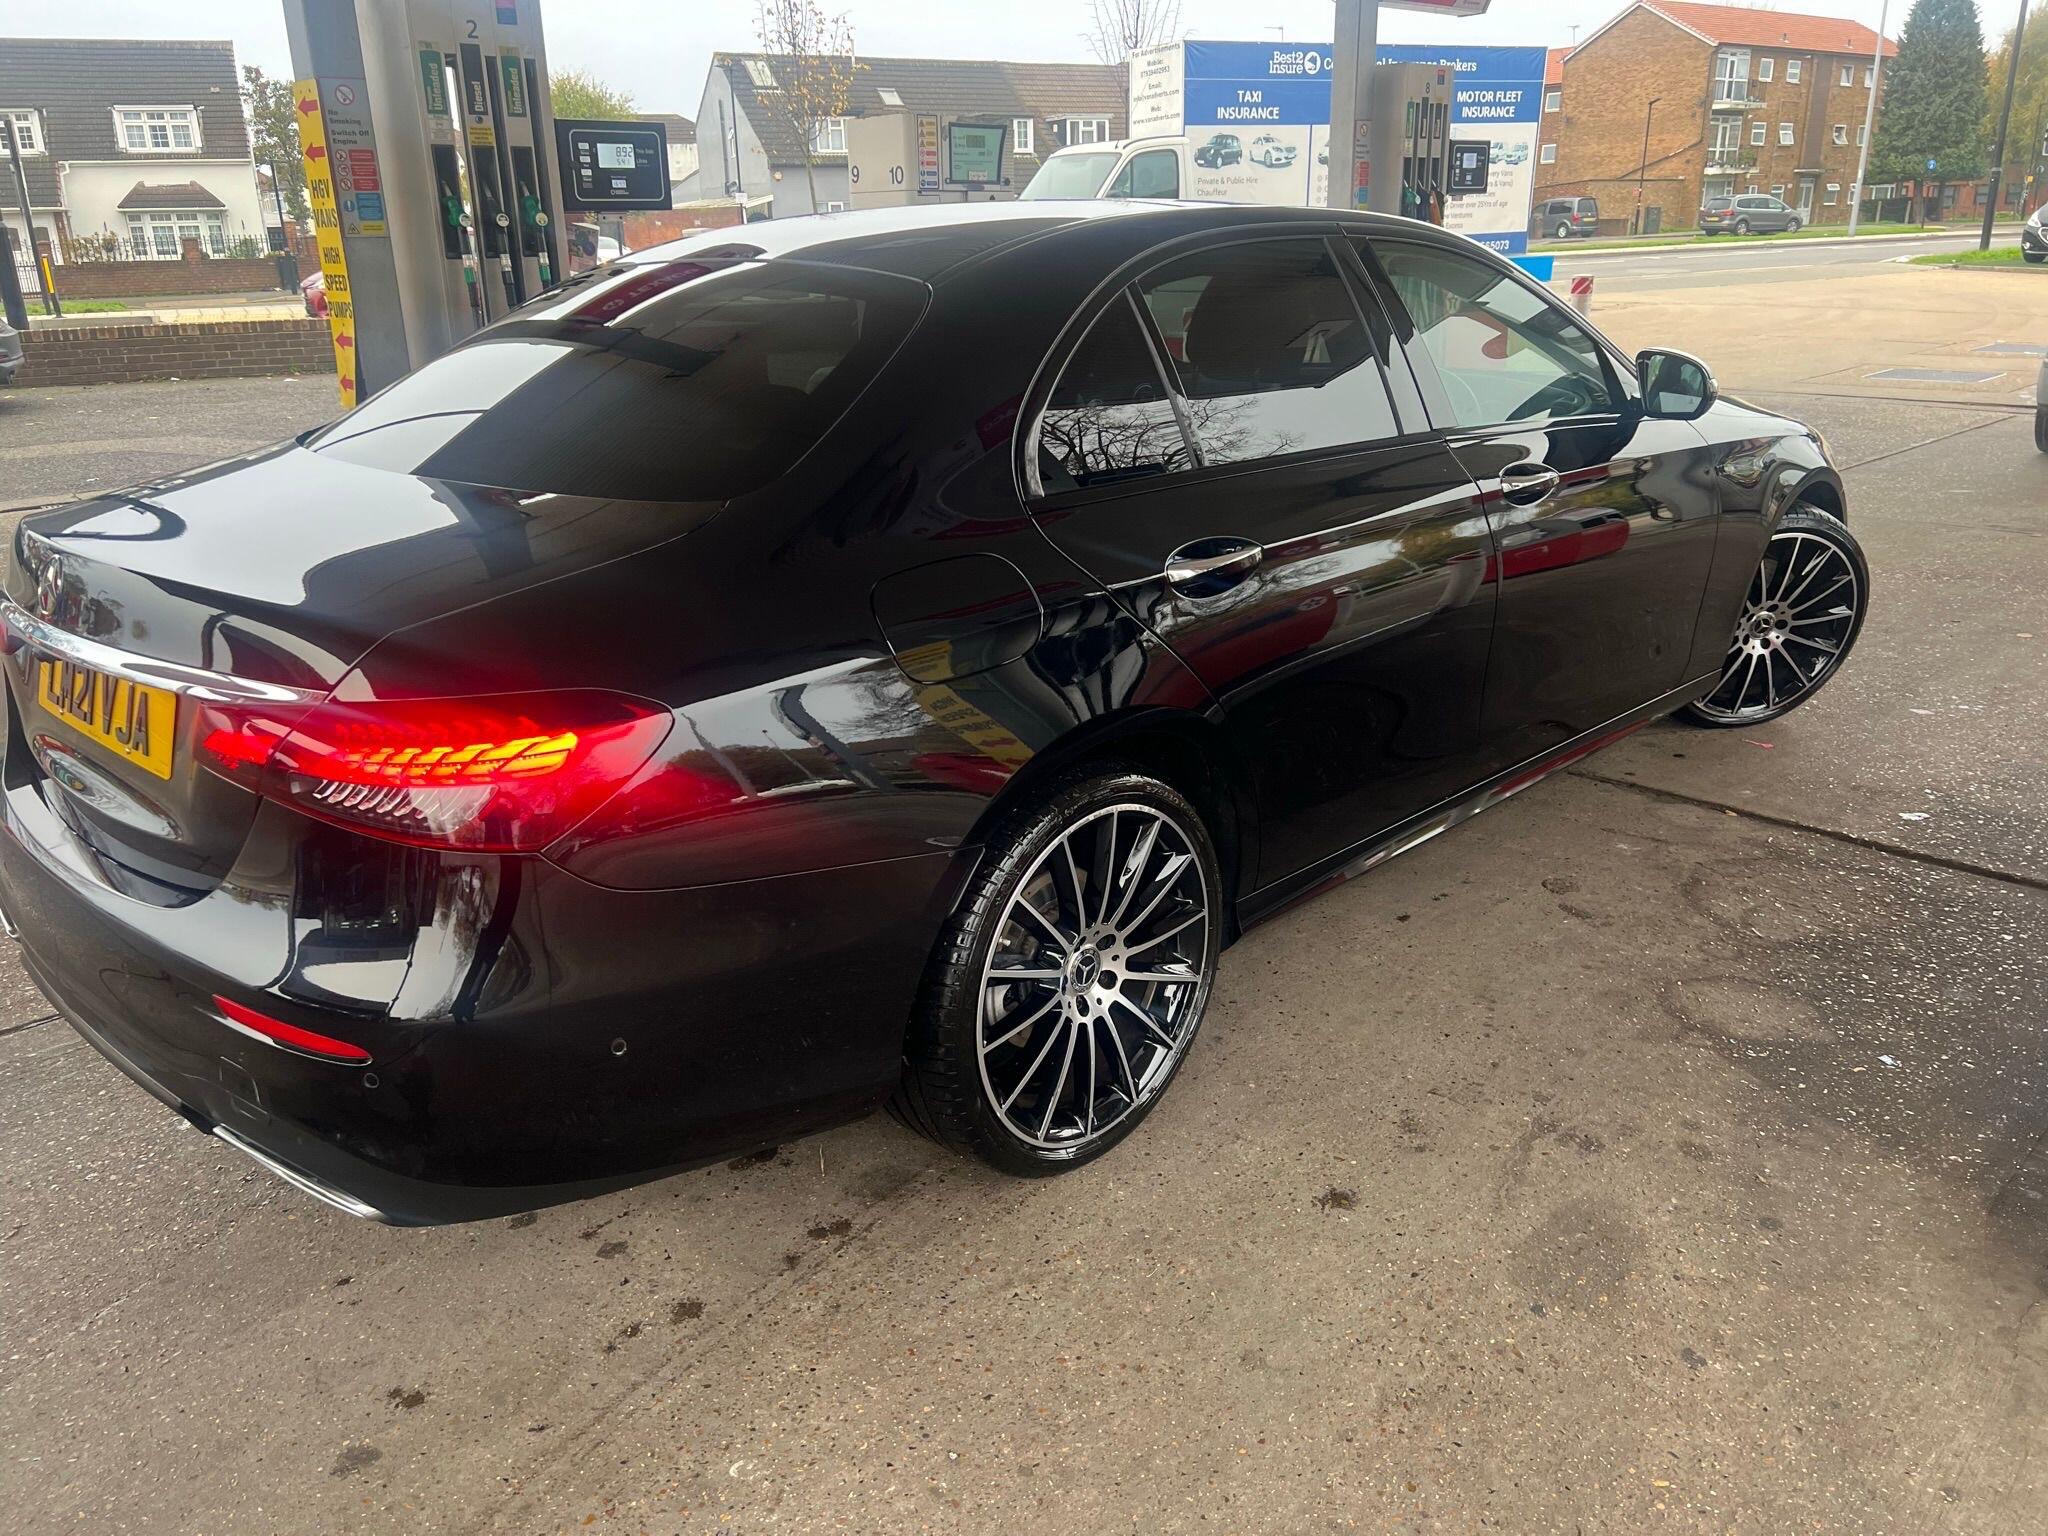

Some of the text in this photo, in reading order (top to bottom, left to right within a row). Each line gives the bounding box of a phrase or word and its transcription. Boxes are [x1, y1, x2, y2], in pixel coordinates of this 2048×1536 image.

[466, 20, 479, 38] 2
[1274, 51, 1304, 64] Best2
[1269, 60, 1304, 74] Insure
[428, 63, 443, 111] Unleaded
[509, 68, 523, 114] Unleaded
[1425, 82, 1431, 94] 8
[472, 81, 484, 112] Diesel
[1237, 90, 1262, 103] TAXI
[1457, 91, 1523, 103] MOTOR FLEET
[1217, 106, 1280, 120] INSURANCE
[1462, 106, 1516, 118] INSURANCE
[329, 118, 362, 126] Smoking
[331, 129, 357, 137] Switch
[332, 138, 358, 146] Engine
[851, 165, 860, 184] 9
[889, 165, 904, 184] 10
[1197, 177, 1220, 185] Private
[1226, 176, 1245, 185] Public
[1246, 176, 1259, 184] Hire
[310, 179, 331, 199] HGV
[1197, 188, 1228, 198] Chauffeur
[313, 207, 338, 229] VANS
[322, 247, 342, 265] HIGH
[325, 274, 348, 292] SPEED
[328, 300, 353, 320] PUMPS
